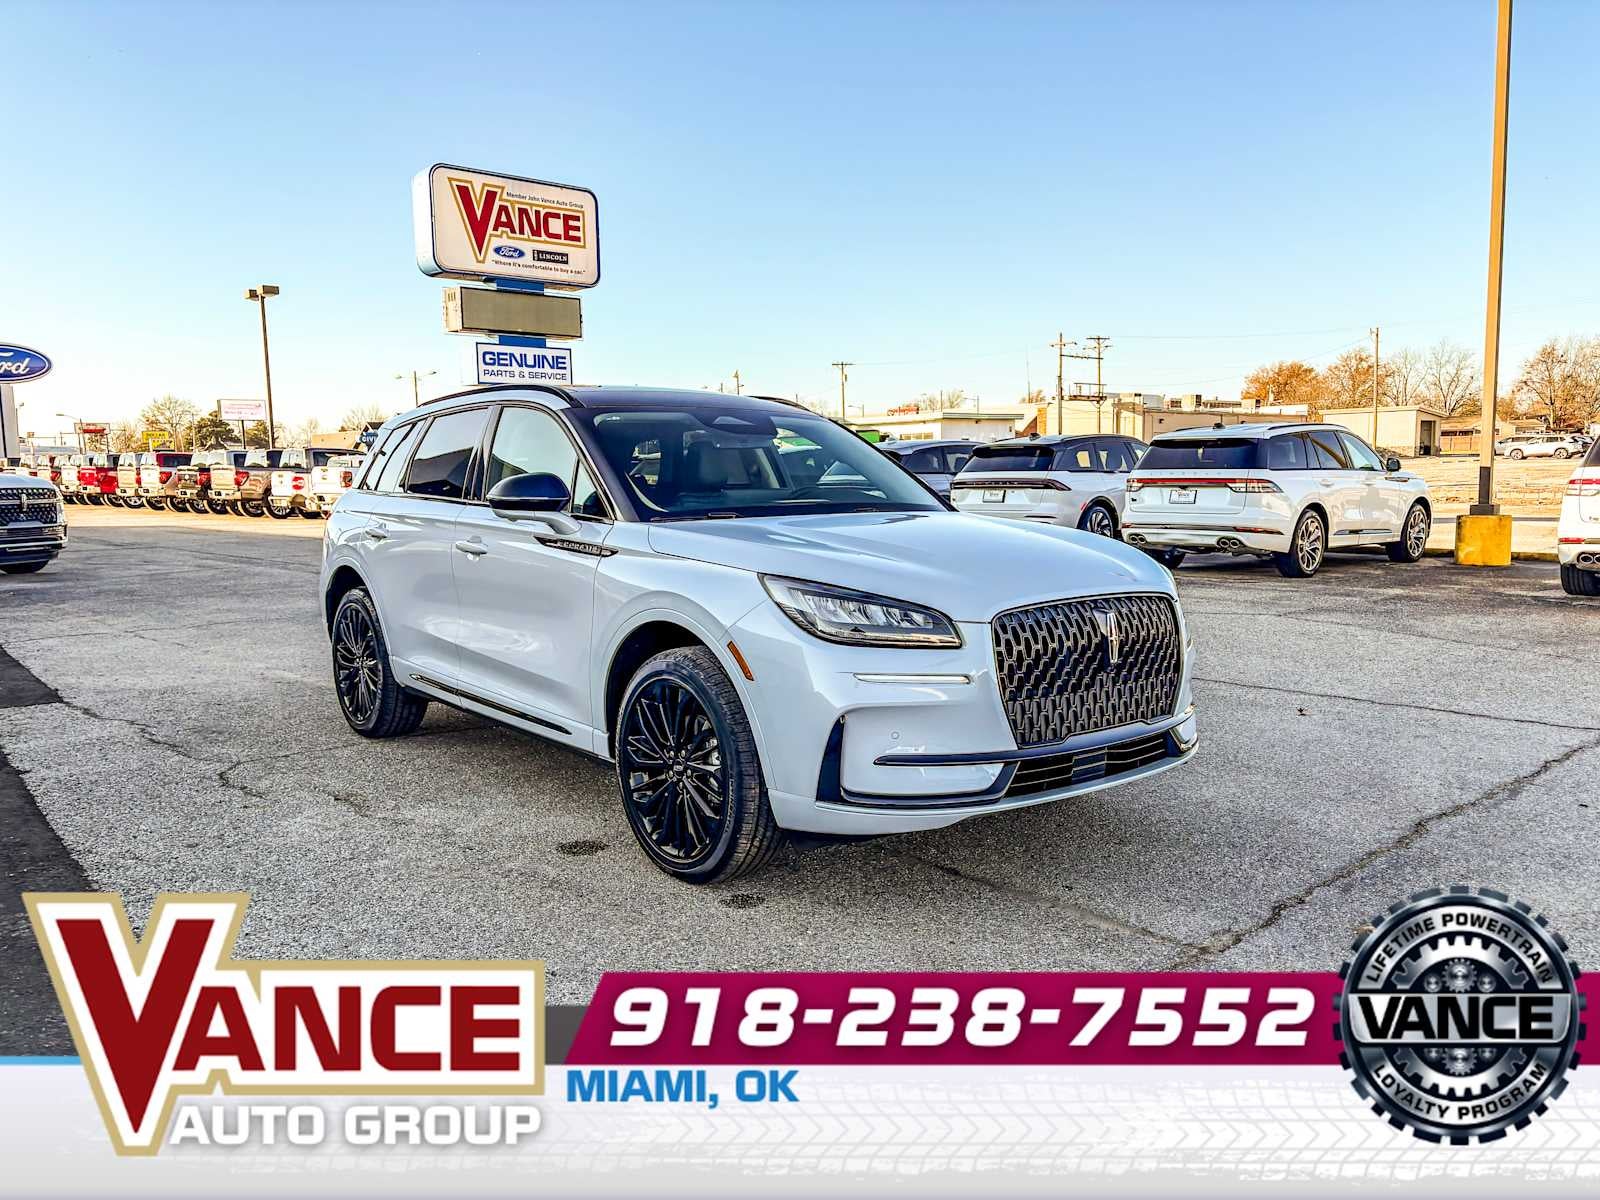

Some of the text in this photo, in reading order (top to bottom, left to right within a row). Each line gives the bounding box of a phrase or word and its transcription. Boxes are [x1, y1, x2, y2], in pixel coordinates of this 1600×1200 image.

[506, 191, 527, 200] Member
[541, 197, 555, 205] Vance
[455, 184, 582, 255] VANCE
[499, 246, 520, 257] Ford
[539, 253, 568, 262] LINCOLN
[522, 263, 553, 271] comfortable
[482, 351, 567, 370] GENUINE
[483, 369, 567, 381] PARTS & SERVICE
